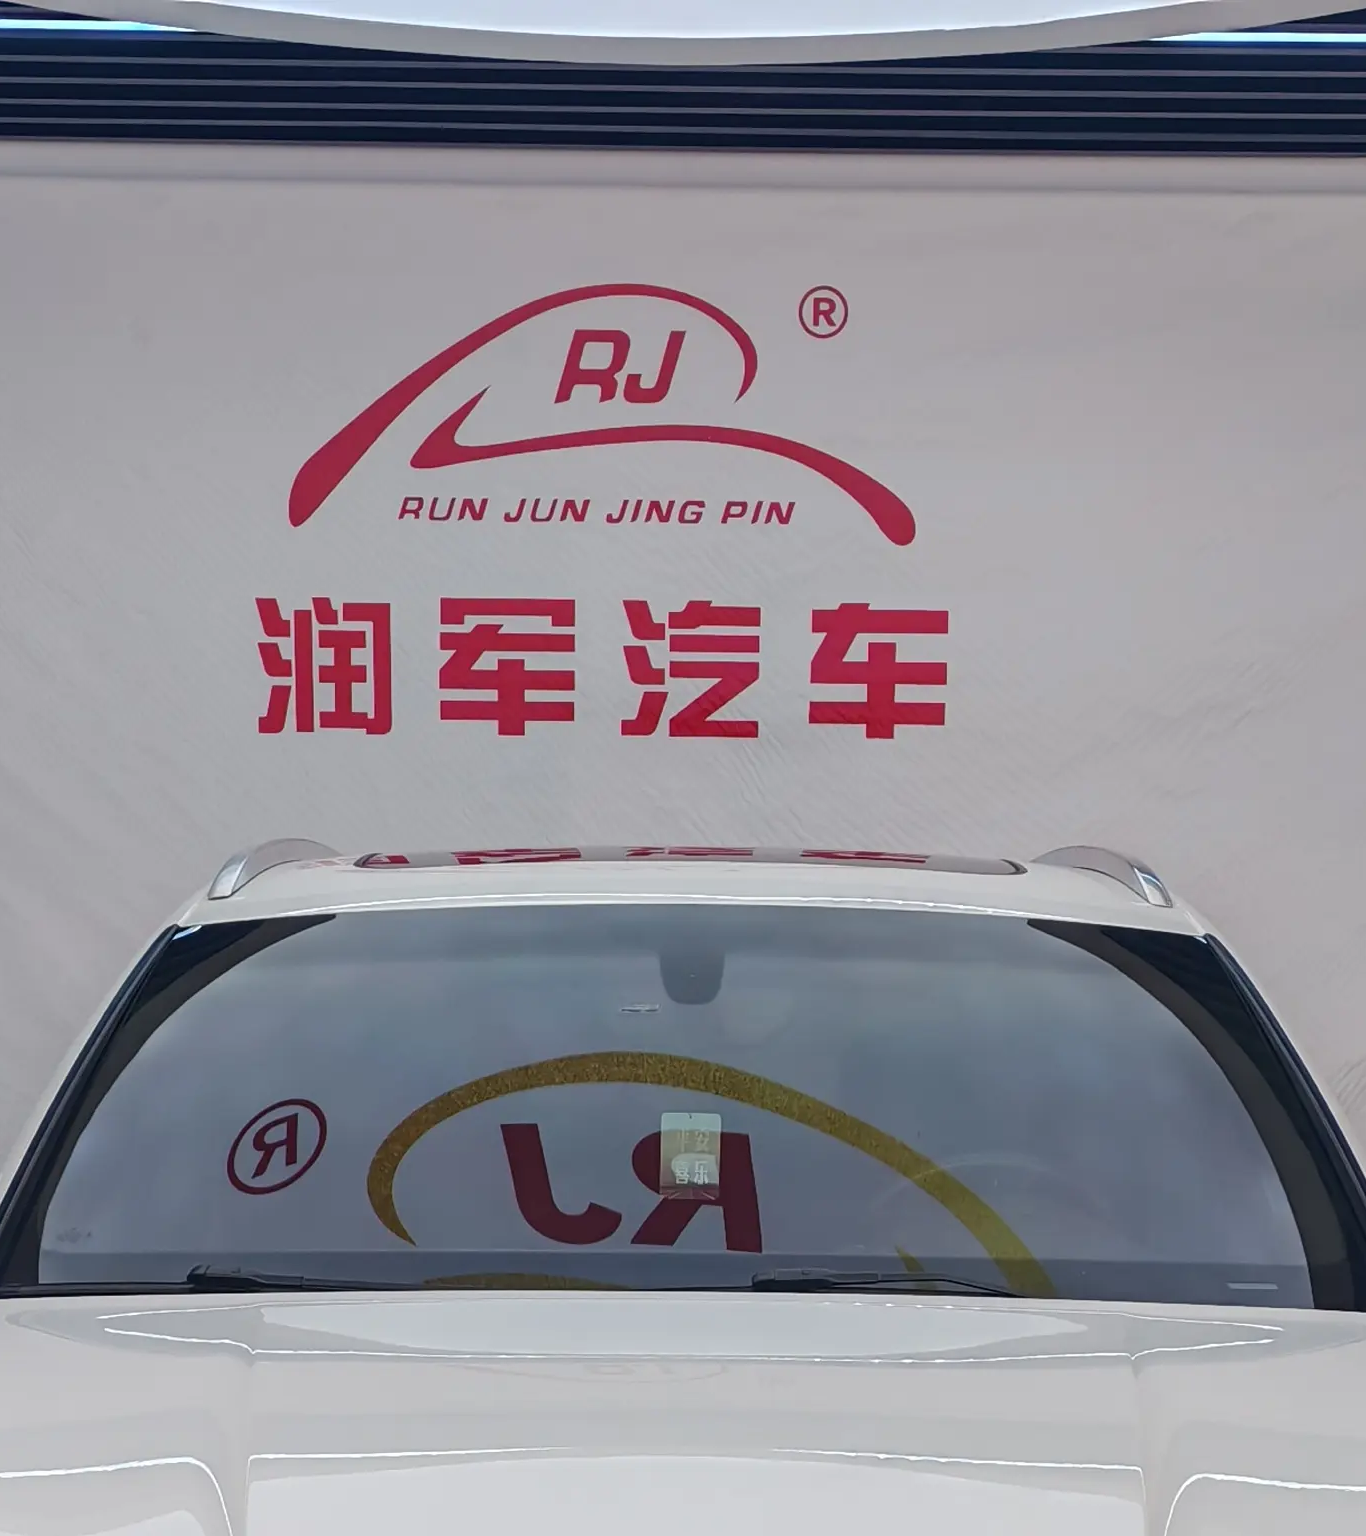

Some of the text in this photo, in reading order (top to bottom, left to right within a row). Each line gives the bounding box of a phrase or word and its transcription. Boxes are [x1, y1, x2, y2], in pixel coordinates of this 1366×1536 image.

[554, 329, 686, 404] RJ
[397, 497, 796, 526] RUN JUN JING PIN
[255, 597, 949, 739] 润军汽车
